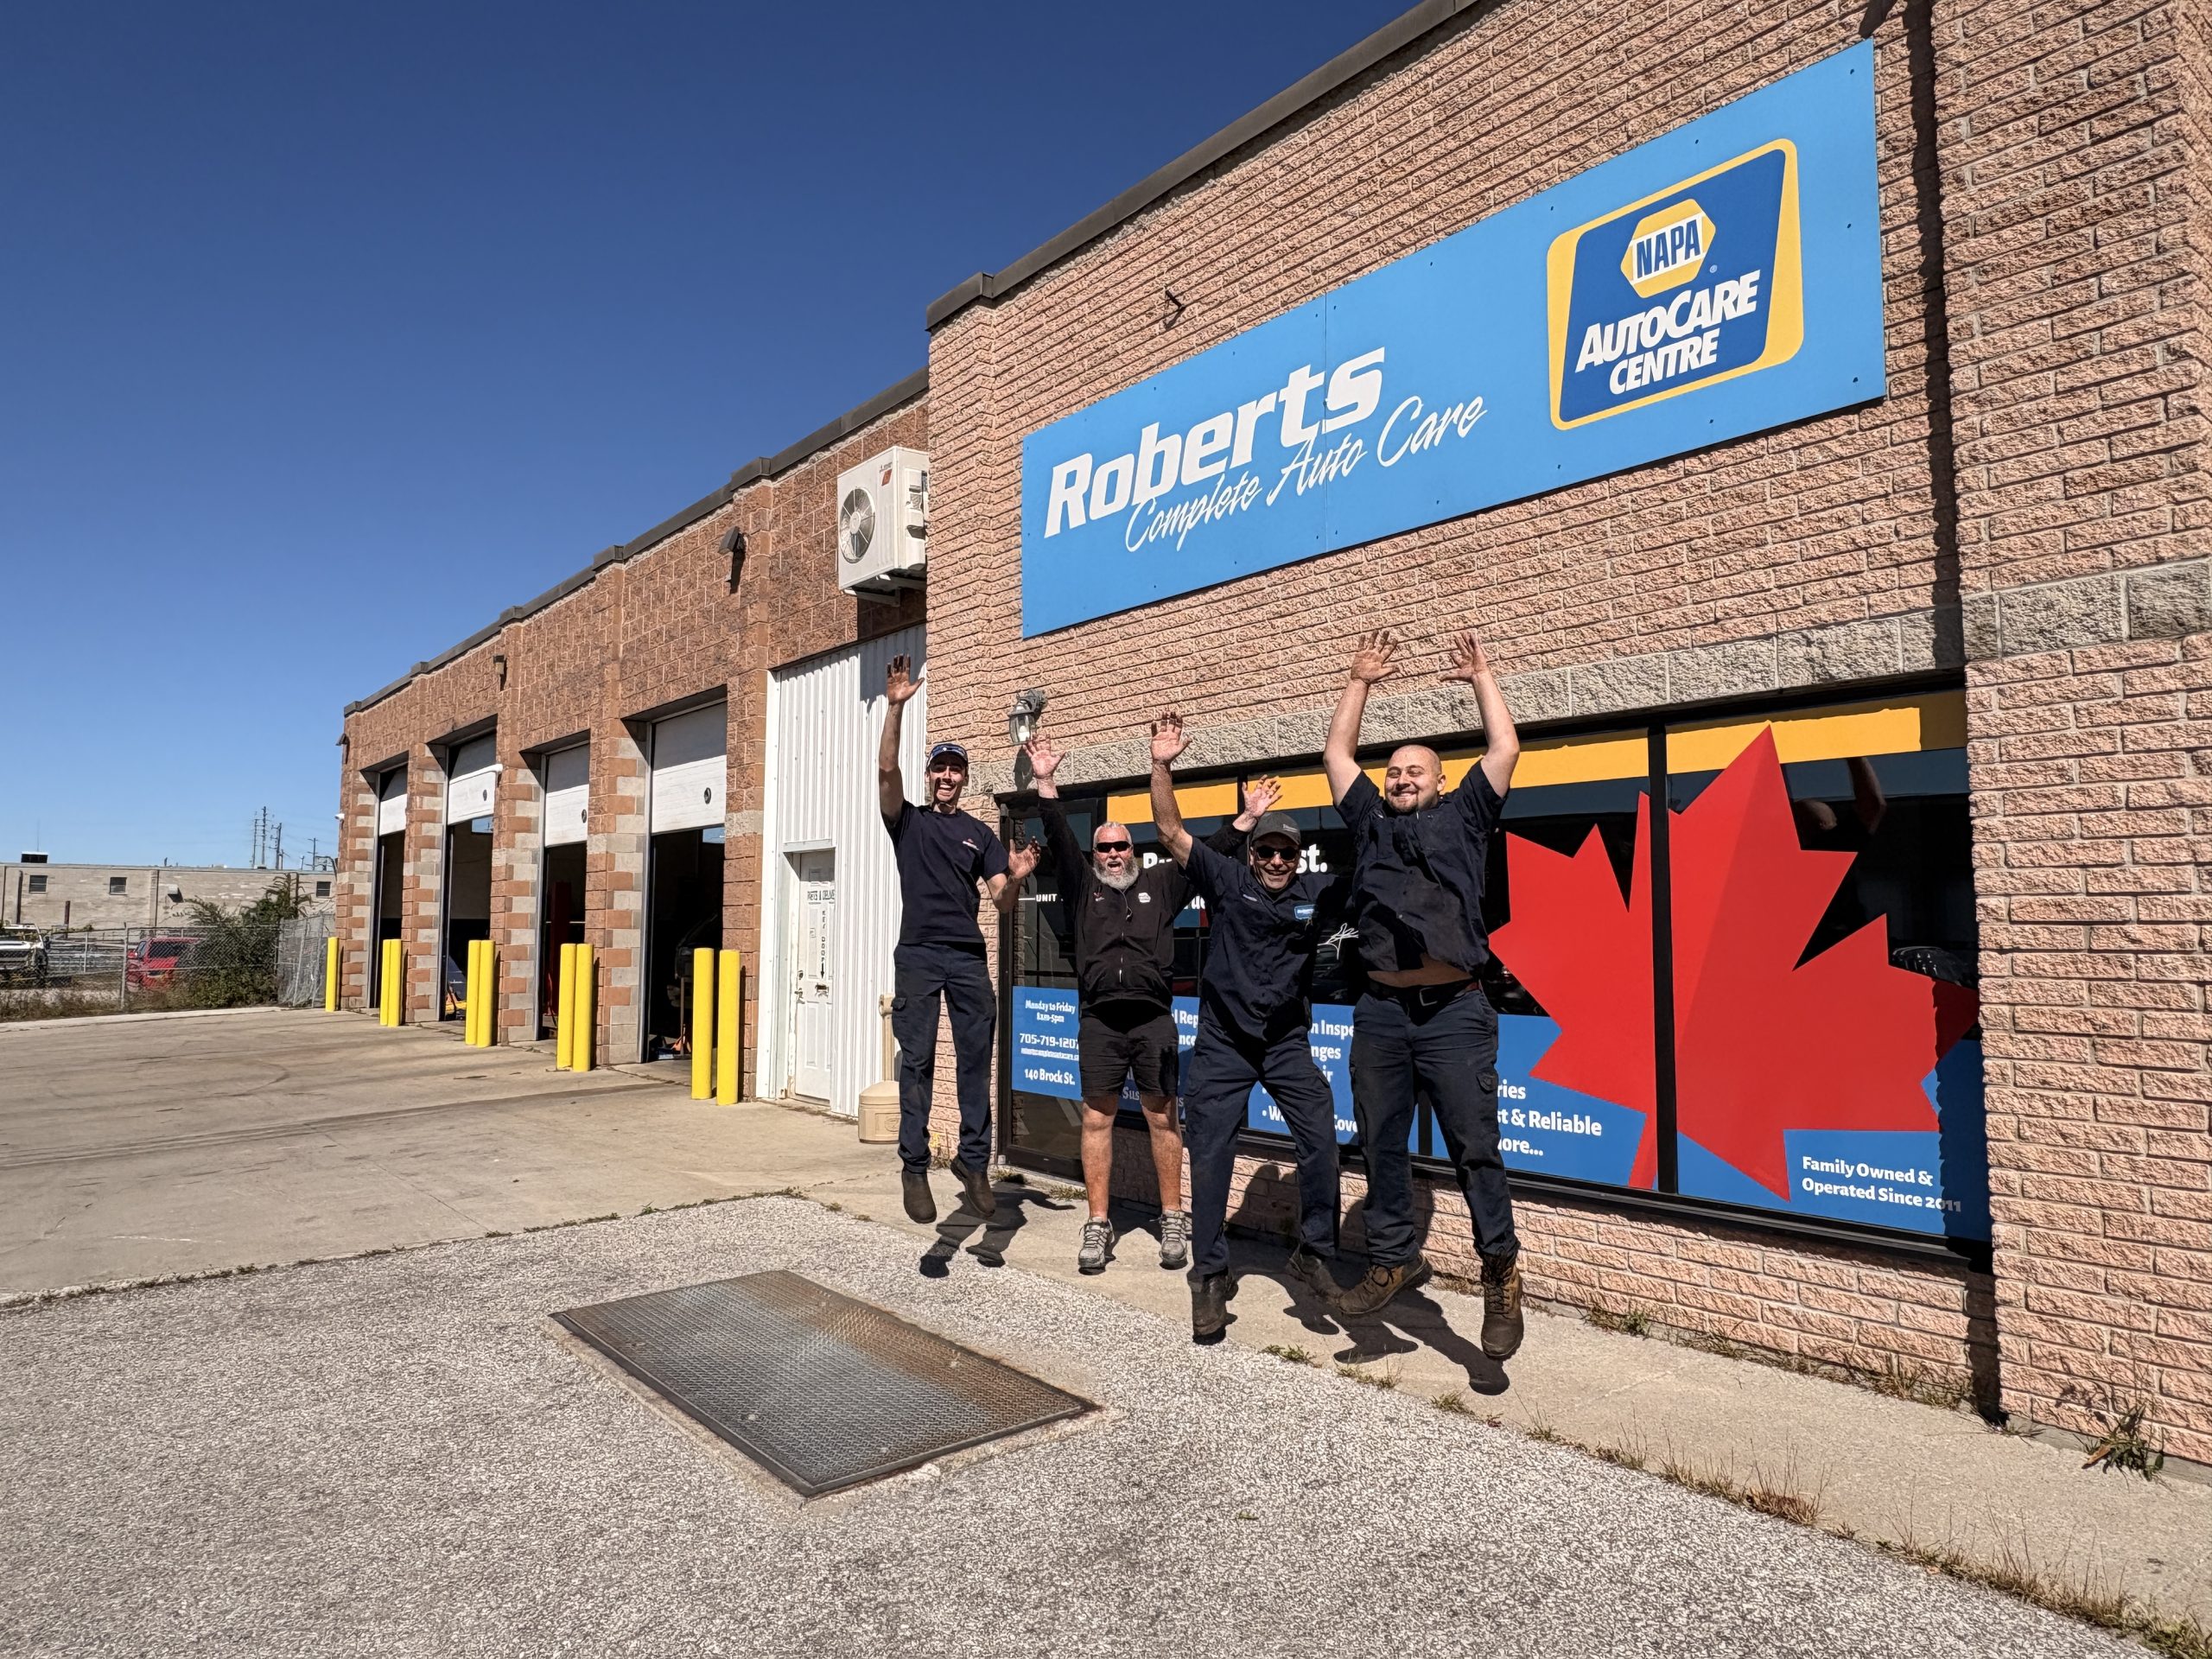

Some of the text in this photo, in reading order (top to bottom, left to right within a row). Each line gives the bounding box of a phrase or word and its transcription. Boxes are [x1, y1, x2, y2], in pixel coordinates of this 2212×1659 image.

[1636, 219, 1700, 279] NAPA
[1574, 269, 1761, 373] AUTOCARE
[1609, 327, 1720, 395] CENTRE
[1044, 346, 1385, 539] Roberts
[1124, 395, 1488, 553] Complete Auto Care
[1296, 843, 1328, 874] st.
[1025, 1000, 1076, 1014] Monday to Friday
[1311, 1046, 1342, 1062] nges
[1024, 1068, 1076, 1085] 140 Brock St.
[1497, 1078, 1527, 1100] ries
[1510, 1109, 1526, 1128] &
[1529, 1109, 1603, 1137] Reliable
[1802, 1155, 1934, 1187] Family Owned &
[1802, 1177, 1961, 1212] Operated Since 2011
